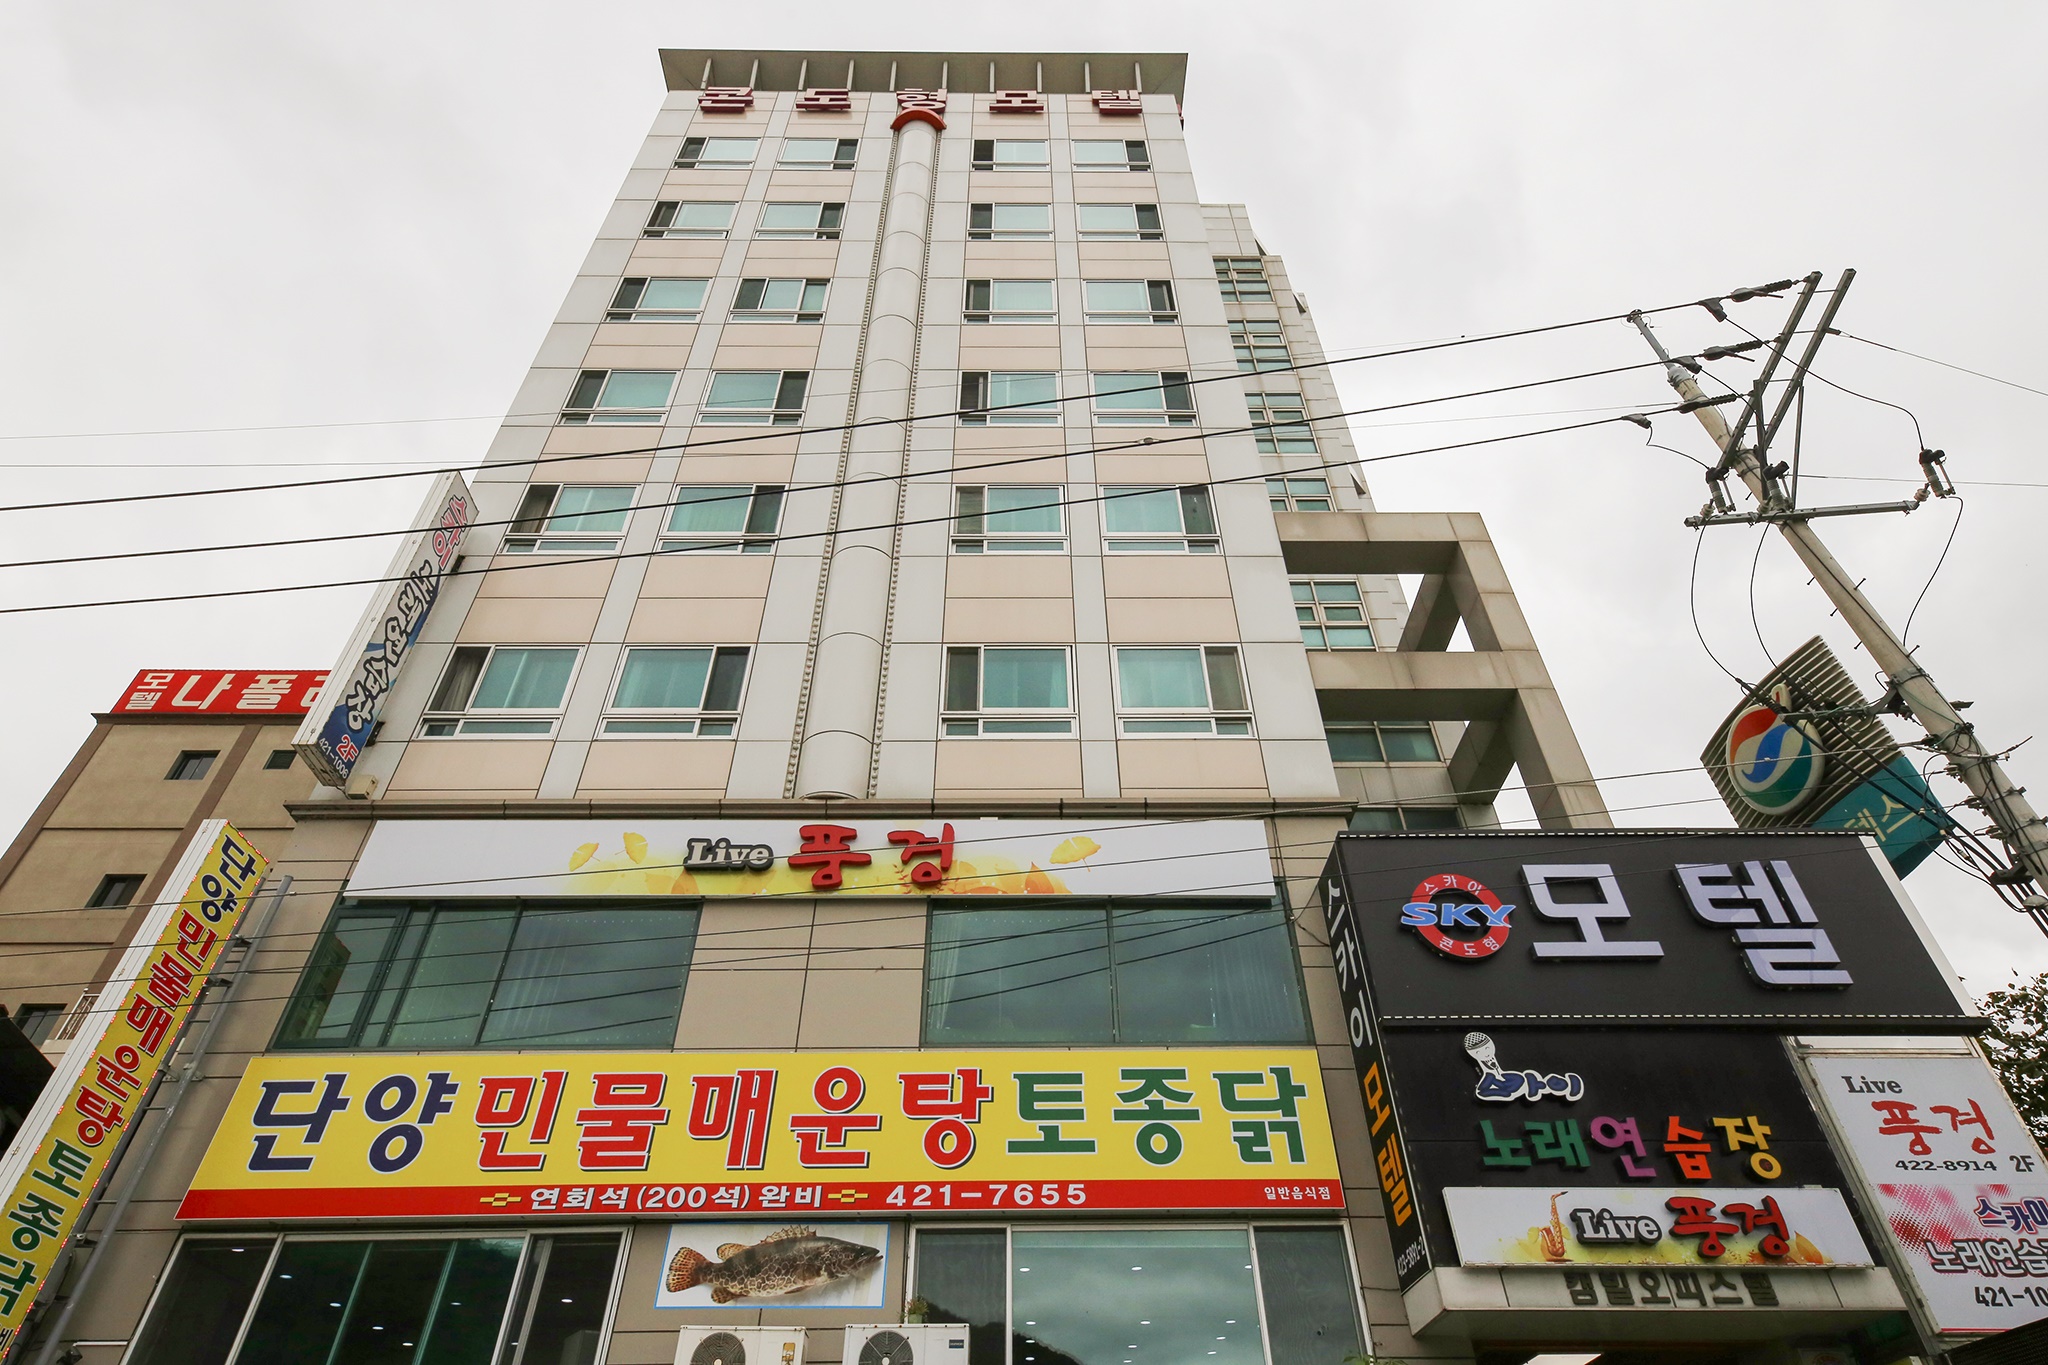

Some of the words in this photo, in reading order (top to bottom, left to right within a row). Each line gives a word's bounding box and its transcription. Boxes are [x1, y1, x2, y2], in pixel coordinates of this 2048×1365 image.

[432, 495, 469, 571] 스카이
[345, 560, 434, 731] 노래연습장
[125, 672, 175, 710] 모텔
[318, 737, 348, 779] 421-1006
[336, 735, 358, 762] 2F
[684, 838, 774, 870] Live
[787, 822, 955, 888] 풍경
[1424, 875, 1482, 895] 스카이
[1401, 902, 1516, 928] SKY
[1521, 860, 1853, 985] 모텔
[1440, 936, 1500, 955] 콘도형
[1327, 878, 1373, 1048] 스카이
[1364, 1061, 1412, 1227] 모텔
[1841, 1075, 1903, 1094] Live
[1871, 1098, 1996, 1156] 풍경
[1480, 1115, 1782, 1180] 노래연습장
[1895, 1160, 1997, 1171] 422-8914
[2009, 1155, 2035, 1172] 2F
[758, 1185, 822, 1210] 완비
[886, 1184, 1087, 1207] 421-7655
[1264, 1186, 1331, 1200] 일반음식점
[1570, 1208, 1662, 1245] Live
[1665, 1195, 1790, 1258] 풍경
